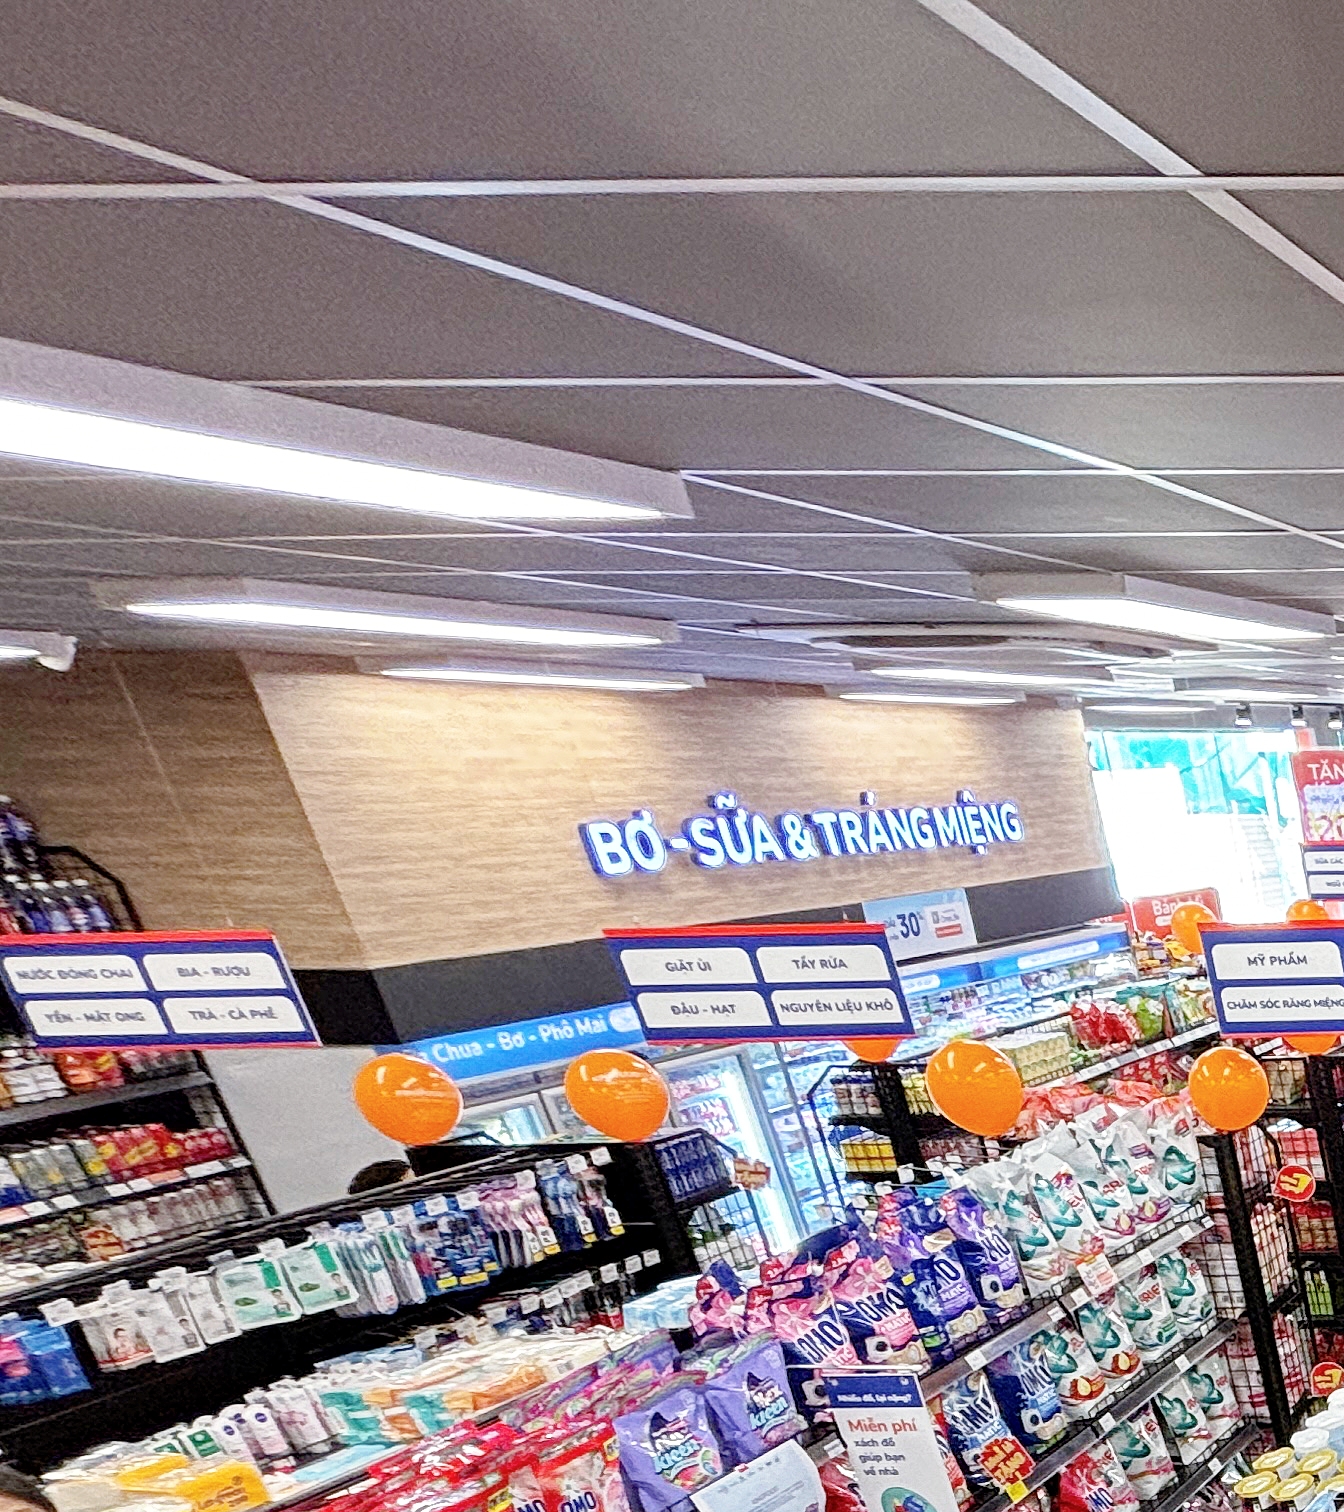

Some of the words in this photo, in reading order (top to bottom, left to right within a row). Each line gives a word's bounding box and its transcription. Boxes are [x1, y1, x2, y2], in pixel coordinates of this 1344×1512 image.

[587, 806, 666, 878] BƠ
[689, 790, 785, 868] SỮA
[784, 810, 817, 861] &
[936, 789, 1025, 855] MIỆNG
[1247, 952, 1265, 968] MỸ
[780, 999, 833, 1014] NGUYÊN
[865, 996, 894, 1013] KHÔ
[433, 1041, 484, 1063] Chua
[496, 1031, 526, 1051] Bơ
[538, 1021, 574, 1043] Phô
[576, 1014, 609, 1035] Mai
[849, 1416, 889, 1434] Miễn
[892, 1419, 918, 1436] phí
[854, 1438, 878, 1448] xách
[884, 1452, 906, 1464] bạn
[878, 1466, 899, 1476] nhà
